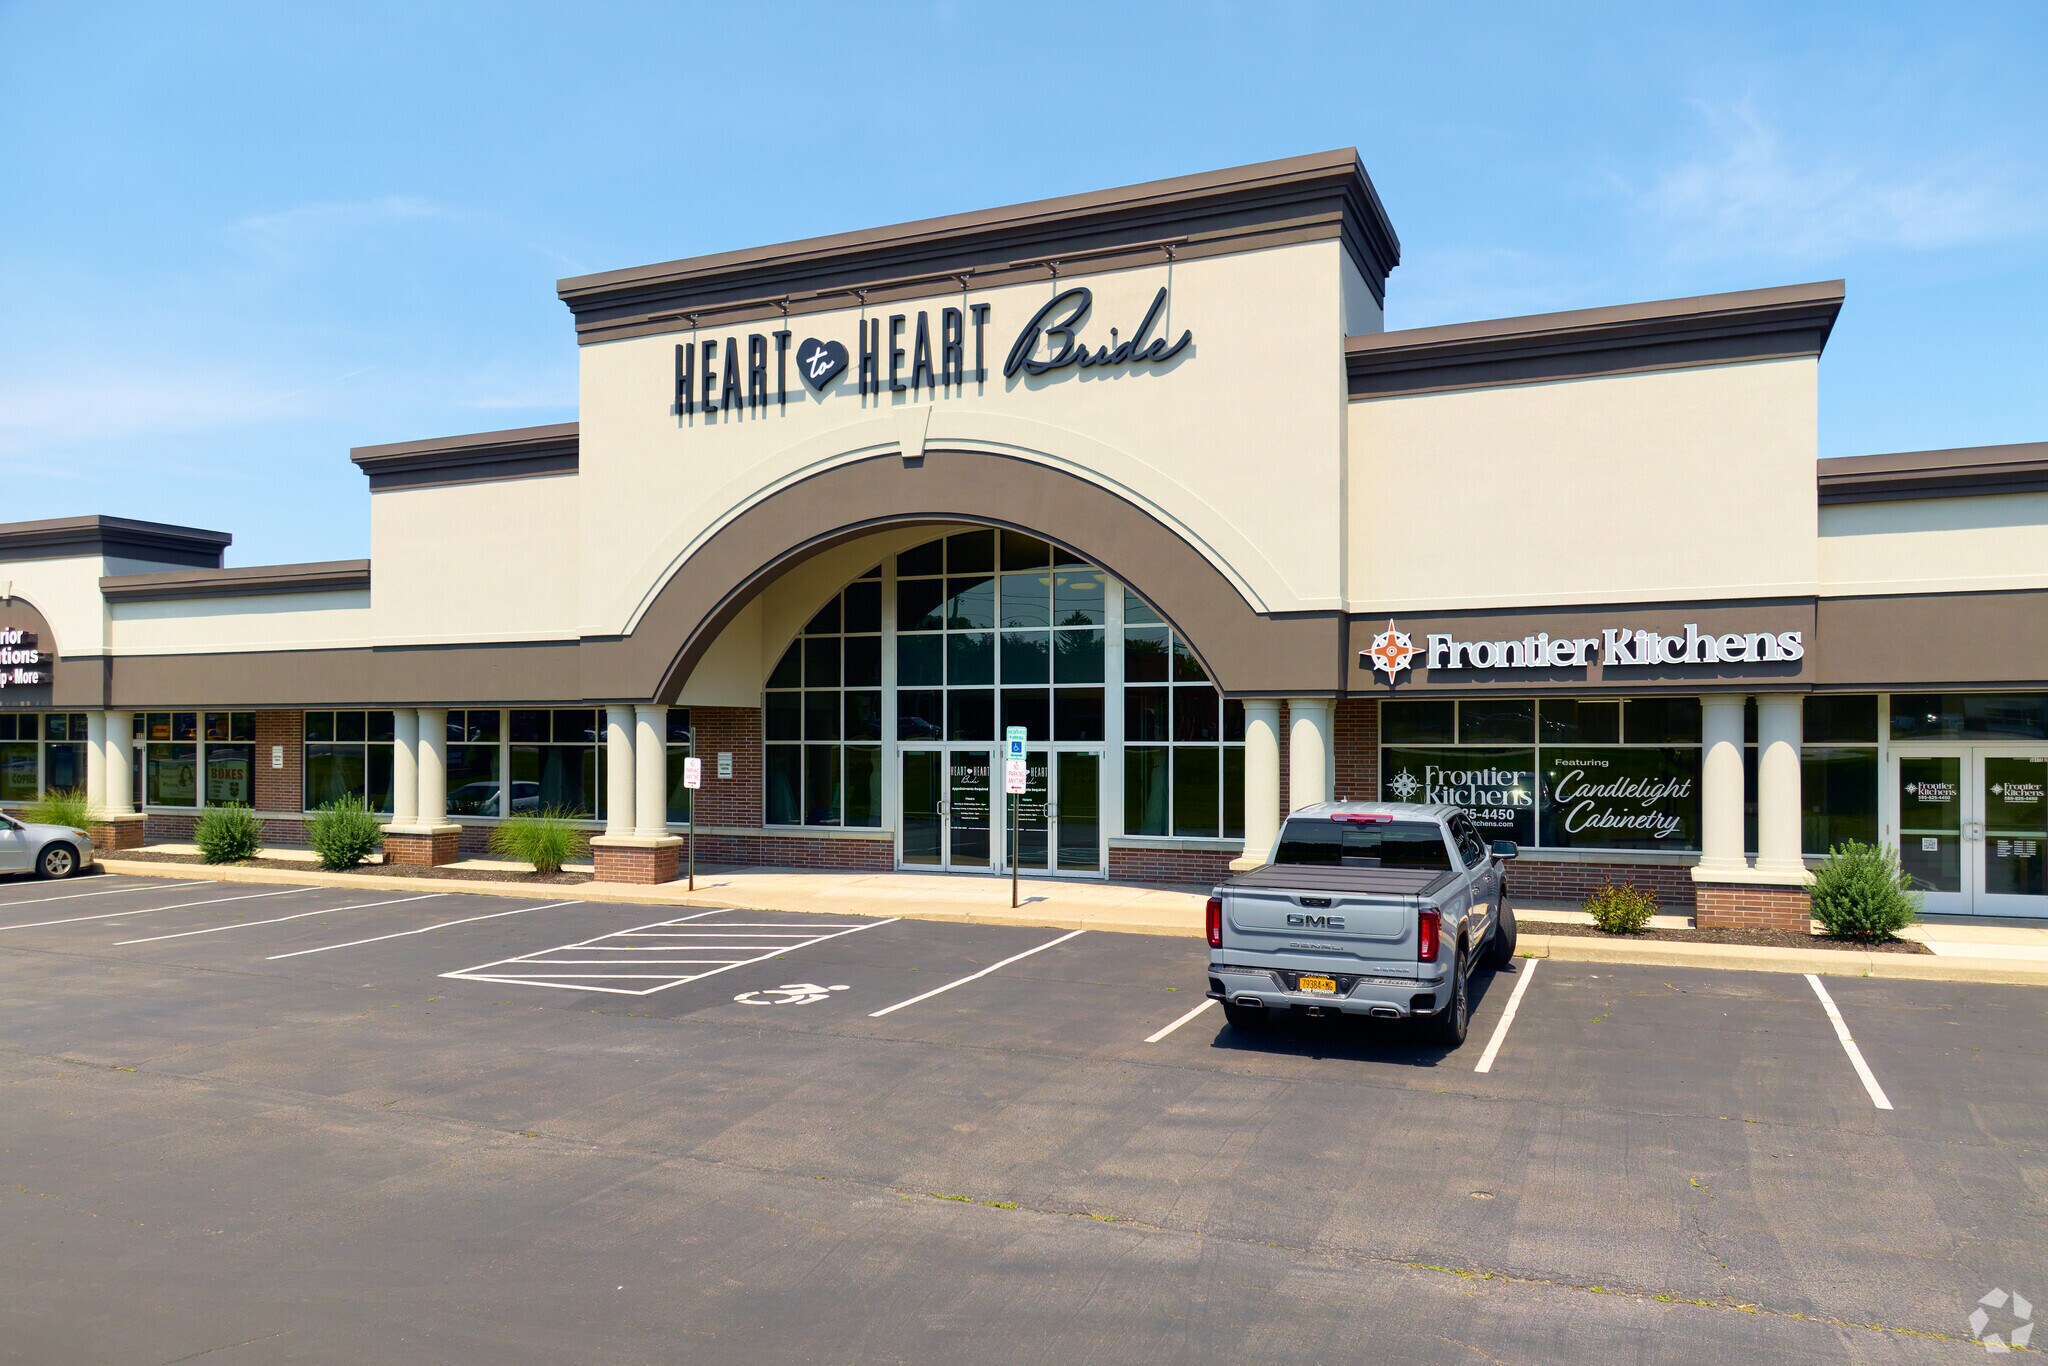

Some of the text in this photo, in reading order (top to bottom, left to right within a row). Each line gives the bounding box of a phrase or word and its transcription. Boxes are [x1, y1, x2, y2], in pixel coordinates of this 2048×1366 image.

[675, 286, 1192, 416] HEART to HEART Bride
[1426, 623, 1805, 670] Frontier Kitchens
[0, 647, 39, 665] tions
[14, 669, 39, 684] More
[950, 766, 990, 776] HEART HEART
[1555, 759, 1609, 768] Featuring
[211, 768, 243, 780] BOXES
[1030, 767, 1048, 777] HEART
[1425, 765, 1527, 786] Frontier
[1425, 784, 1532, 806] Kitchens
[1555, 769, 1691, 807] Candlelight
[1918, 788, 1957, 796] Kitchens
[2004, 789, 2044, 797] Kitchens
[1565, 800, 1680, 838] Cabinetry
[1286, 913, 1345, 928] GMC
[1290, 942, 1344, 951] DENALI
